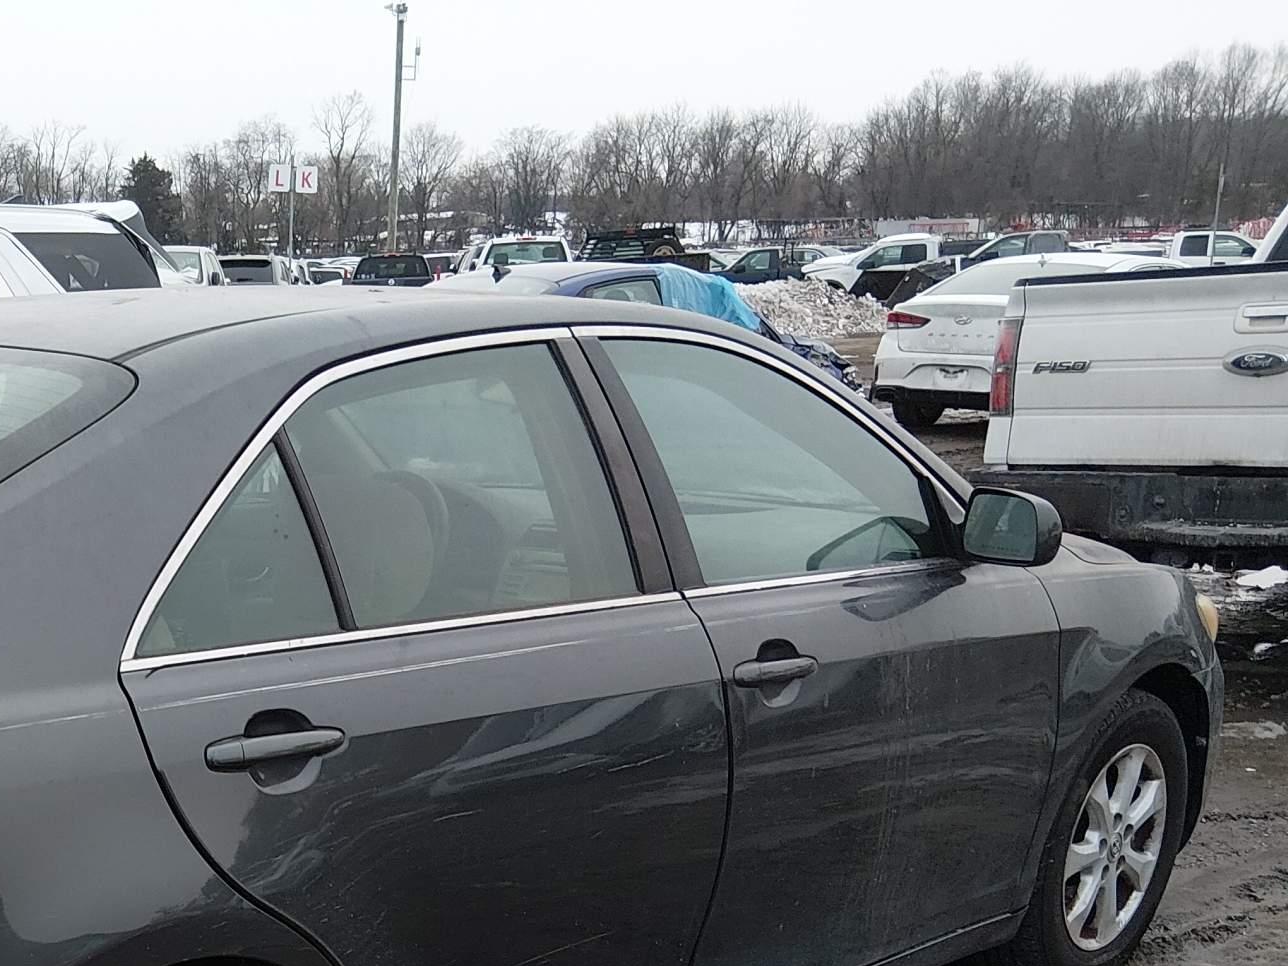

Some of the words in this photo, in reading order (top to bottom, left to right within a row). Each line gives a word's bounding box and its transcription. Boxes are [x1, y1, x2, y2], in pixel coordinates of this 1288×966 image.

[275, 169, 284, 187] L
[301, 171, 313, 188] K
[1239, 354, 1273, 369] Ford
